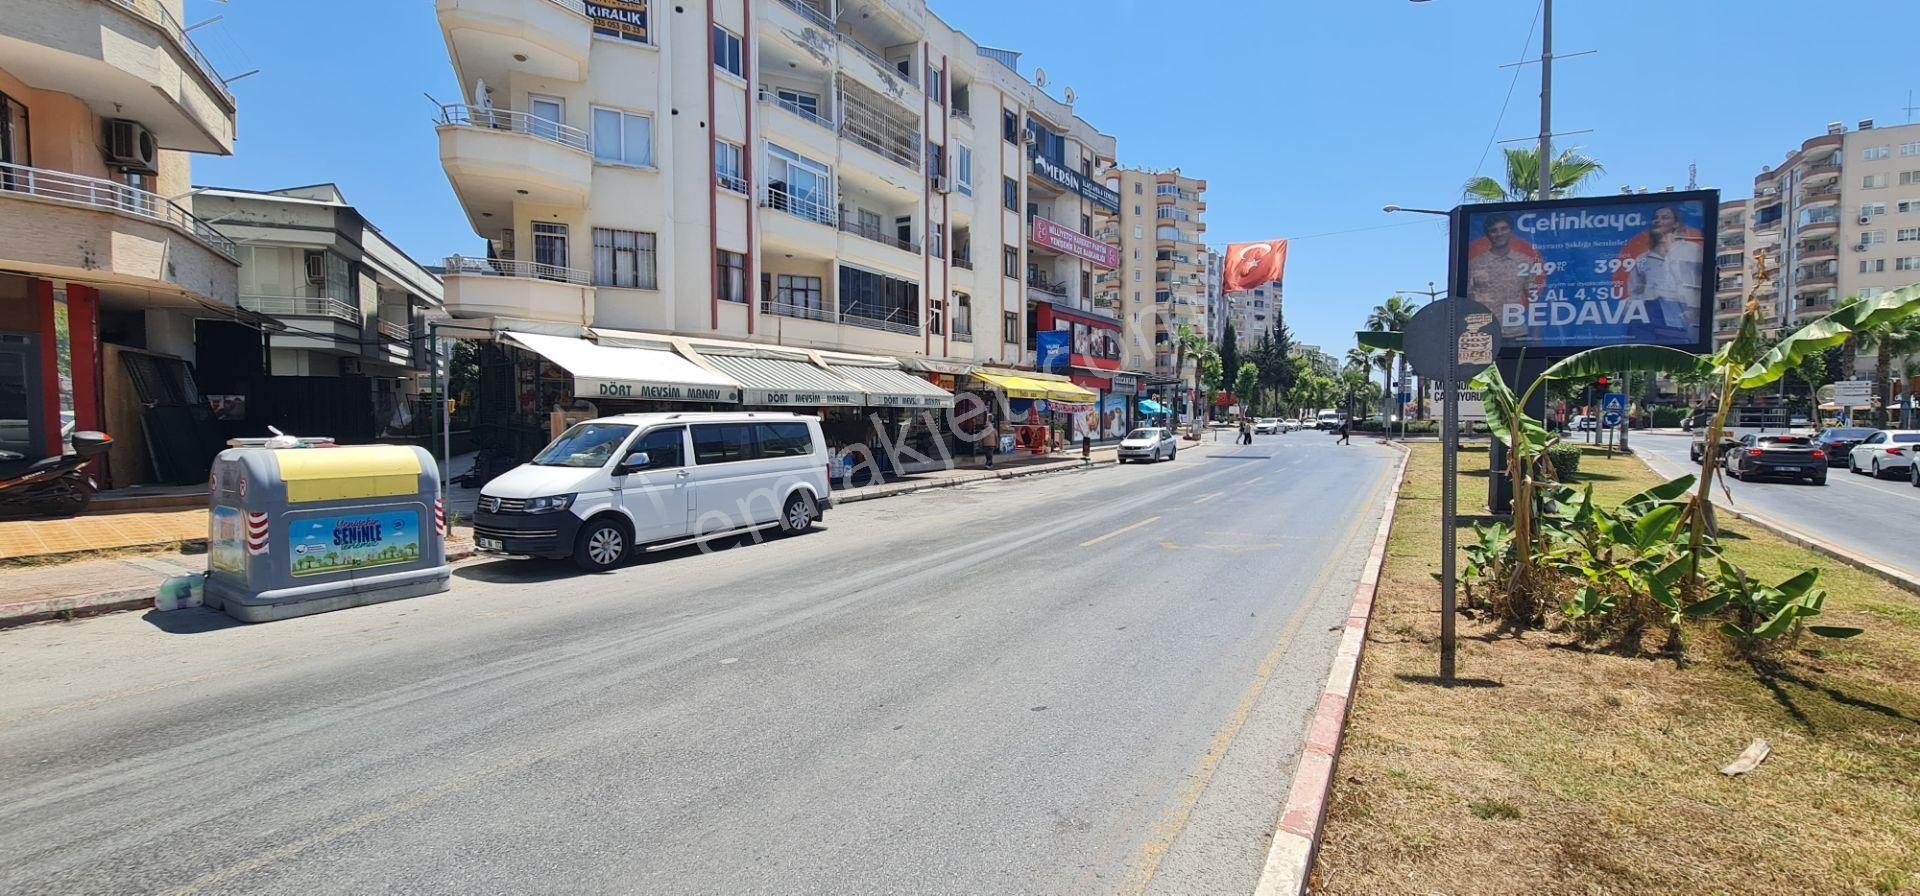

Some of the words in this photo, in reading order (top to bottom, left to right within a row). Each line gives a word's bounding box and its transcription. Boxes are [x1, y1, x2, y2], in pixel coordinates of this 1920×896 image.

[1517, 261, 1556, 276] 249
[1595, 258, 1636, 274] 399
[1528, 289, 1539, 301] 3
[1544, 289, 1568, 301] AL
[1503, 300, 1650, 327] BEDAVA
[600, 381, 632, 396] DÖRT
[641, 384, 680, 398] MEVSİM
[687, 387, 720, 399] MANAV
[767, 391, 788, 403] DÖRT
